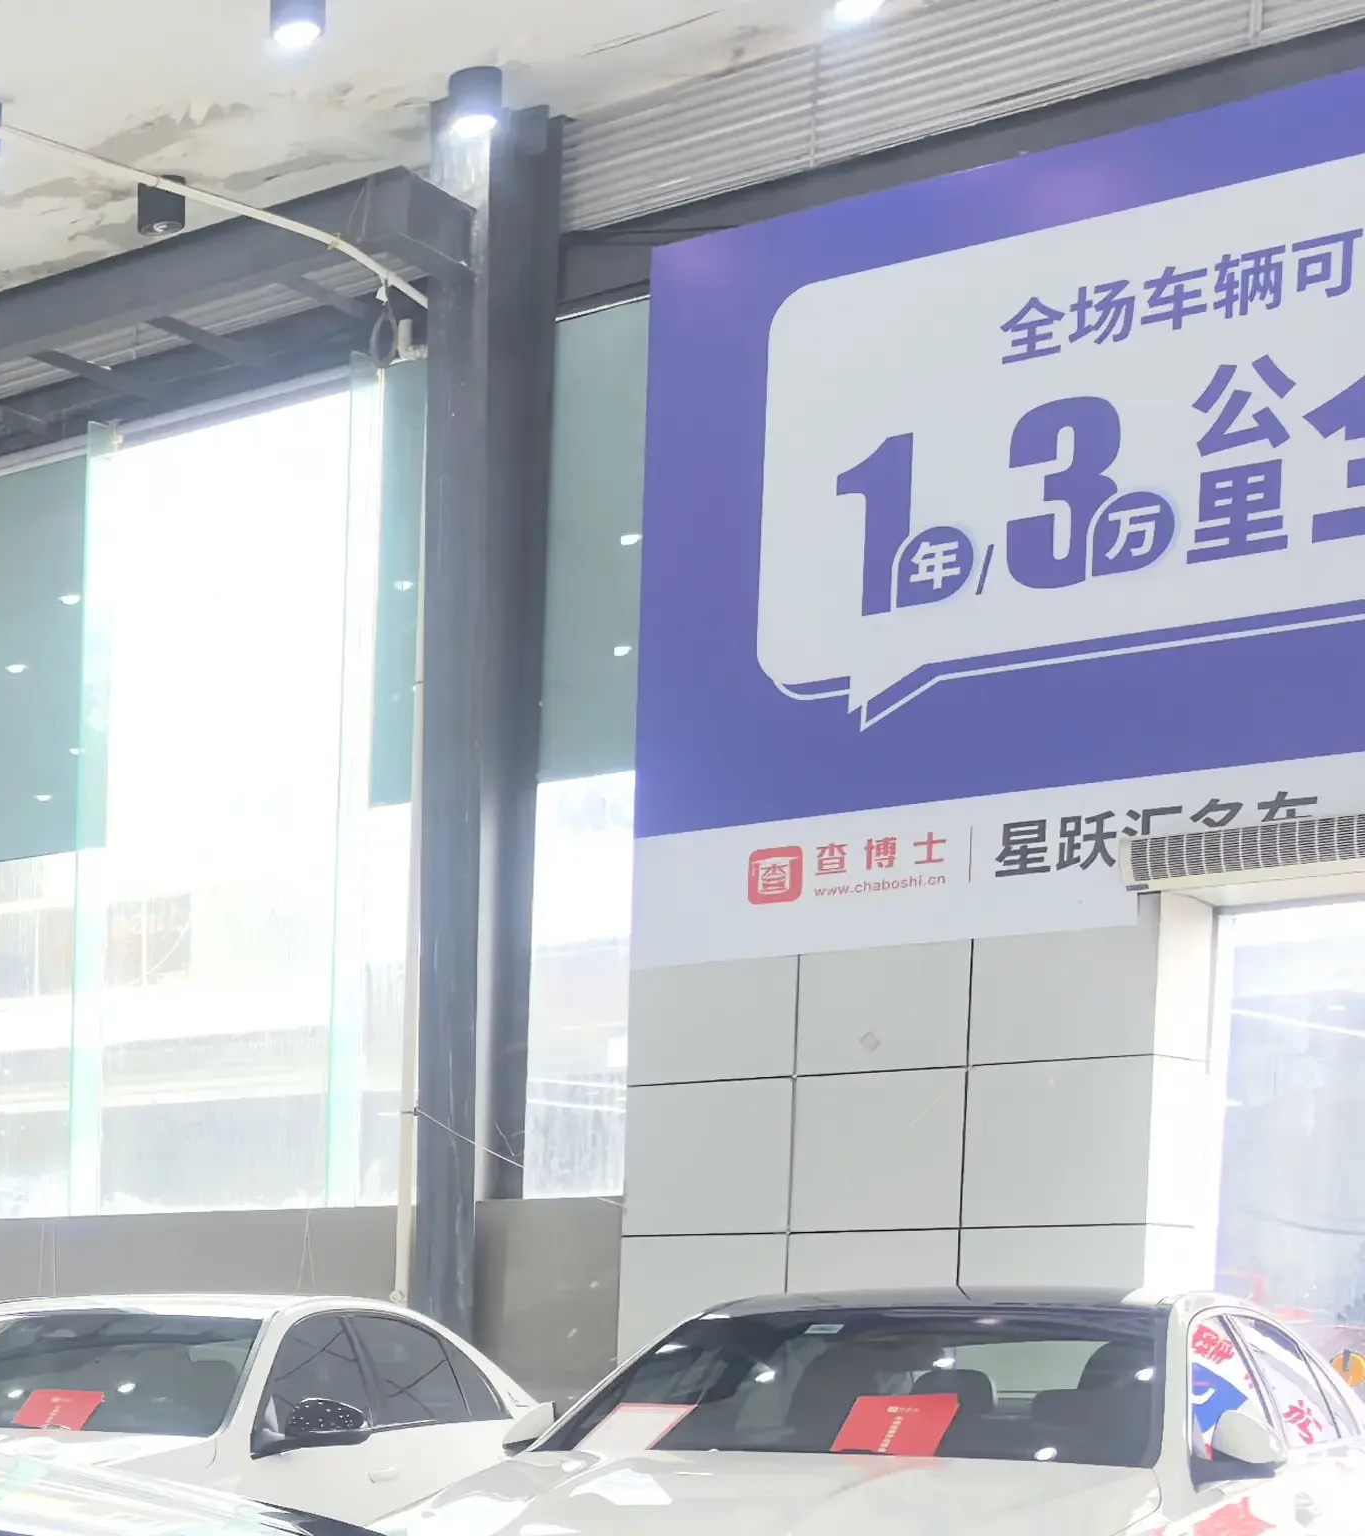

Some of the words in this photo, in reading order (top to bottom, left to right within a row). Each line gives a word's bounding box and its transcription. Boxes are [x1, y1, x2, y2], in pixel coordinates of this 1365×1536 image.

[1000, 228, 1364, 365] 全场车辆可
[815, 832, 947, 875] 查博士
[814, 874, 946, 897] www.chaboshi.cn
